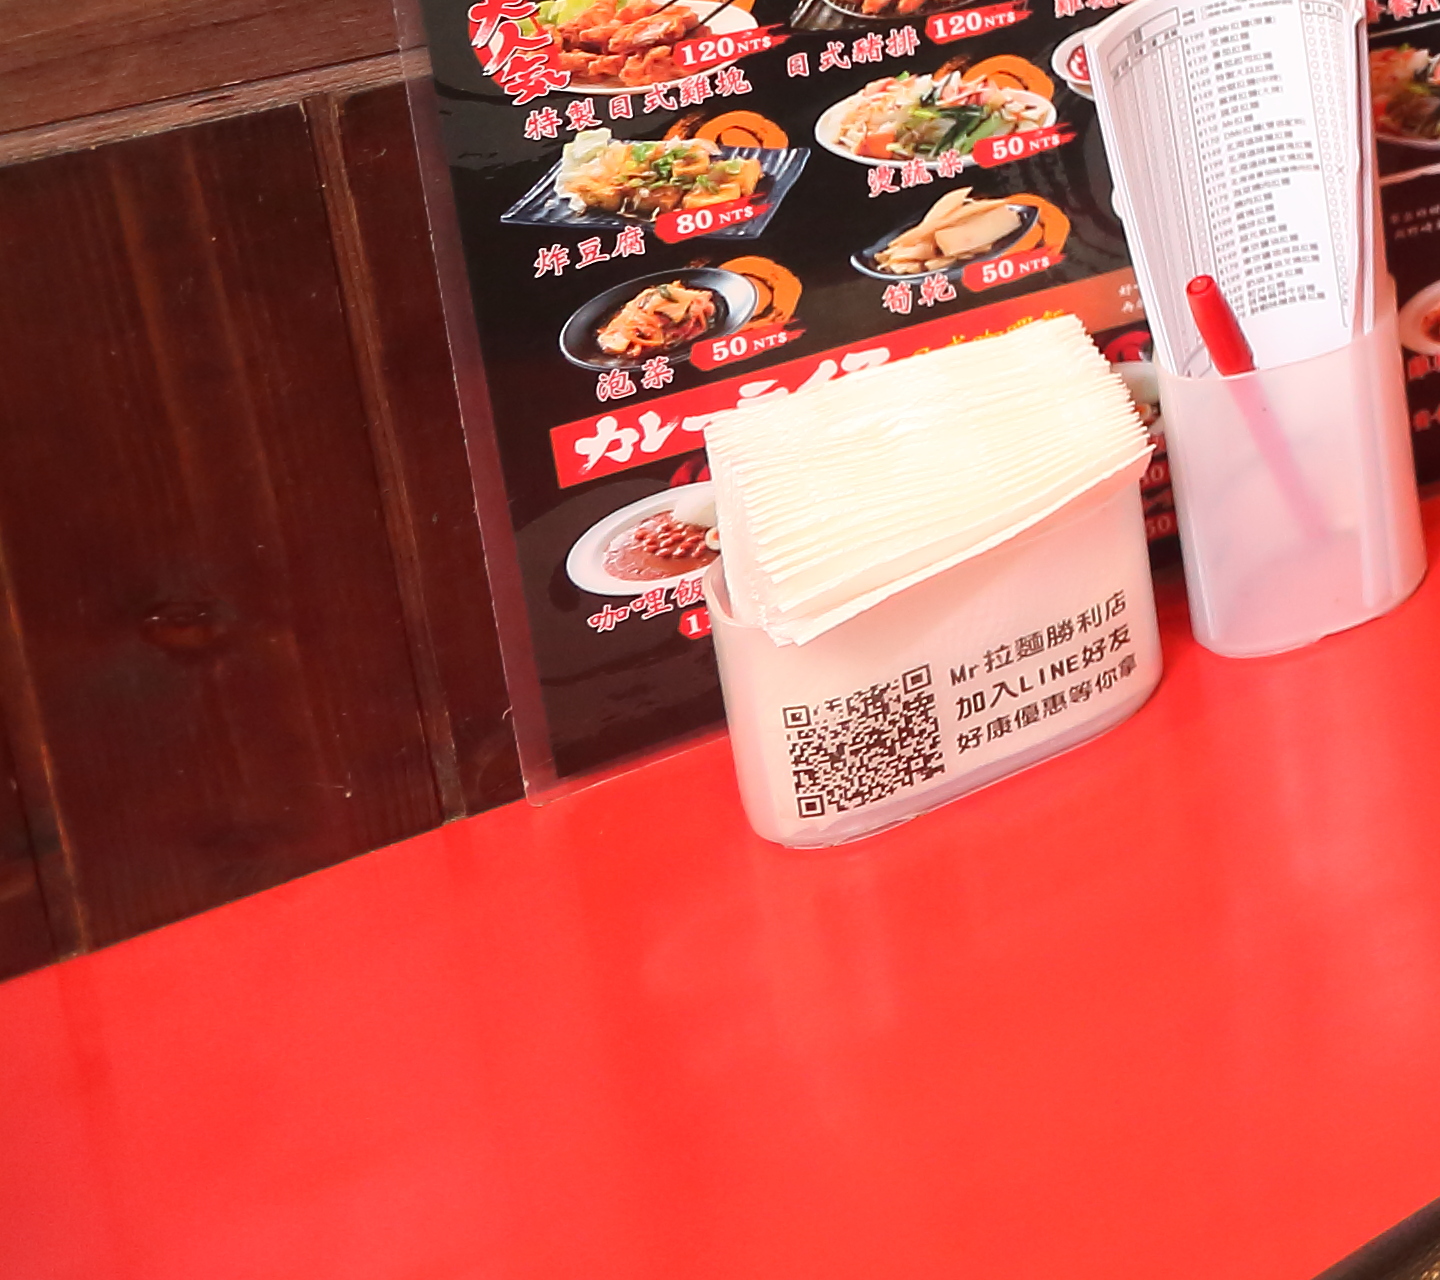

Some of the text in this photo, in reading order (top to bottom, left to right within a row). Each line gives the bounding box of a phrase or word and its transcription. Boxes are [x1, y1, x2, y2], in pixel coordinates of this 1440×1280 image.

[787, 25, 921, 78] 日式豬排
[524, 66, 753, 141] 特製日式雞塊
[533, 226, 646, 278] 炸豆腐
[882, 272, 957, 315] 筍乾
[596, 356, 675, 402] 泡菜
[955, 623, 1131, 722] 加入LINE好友
